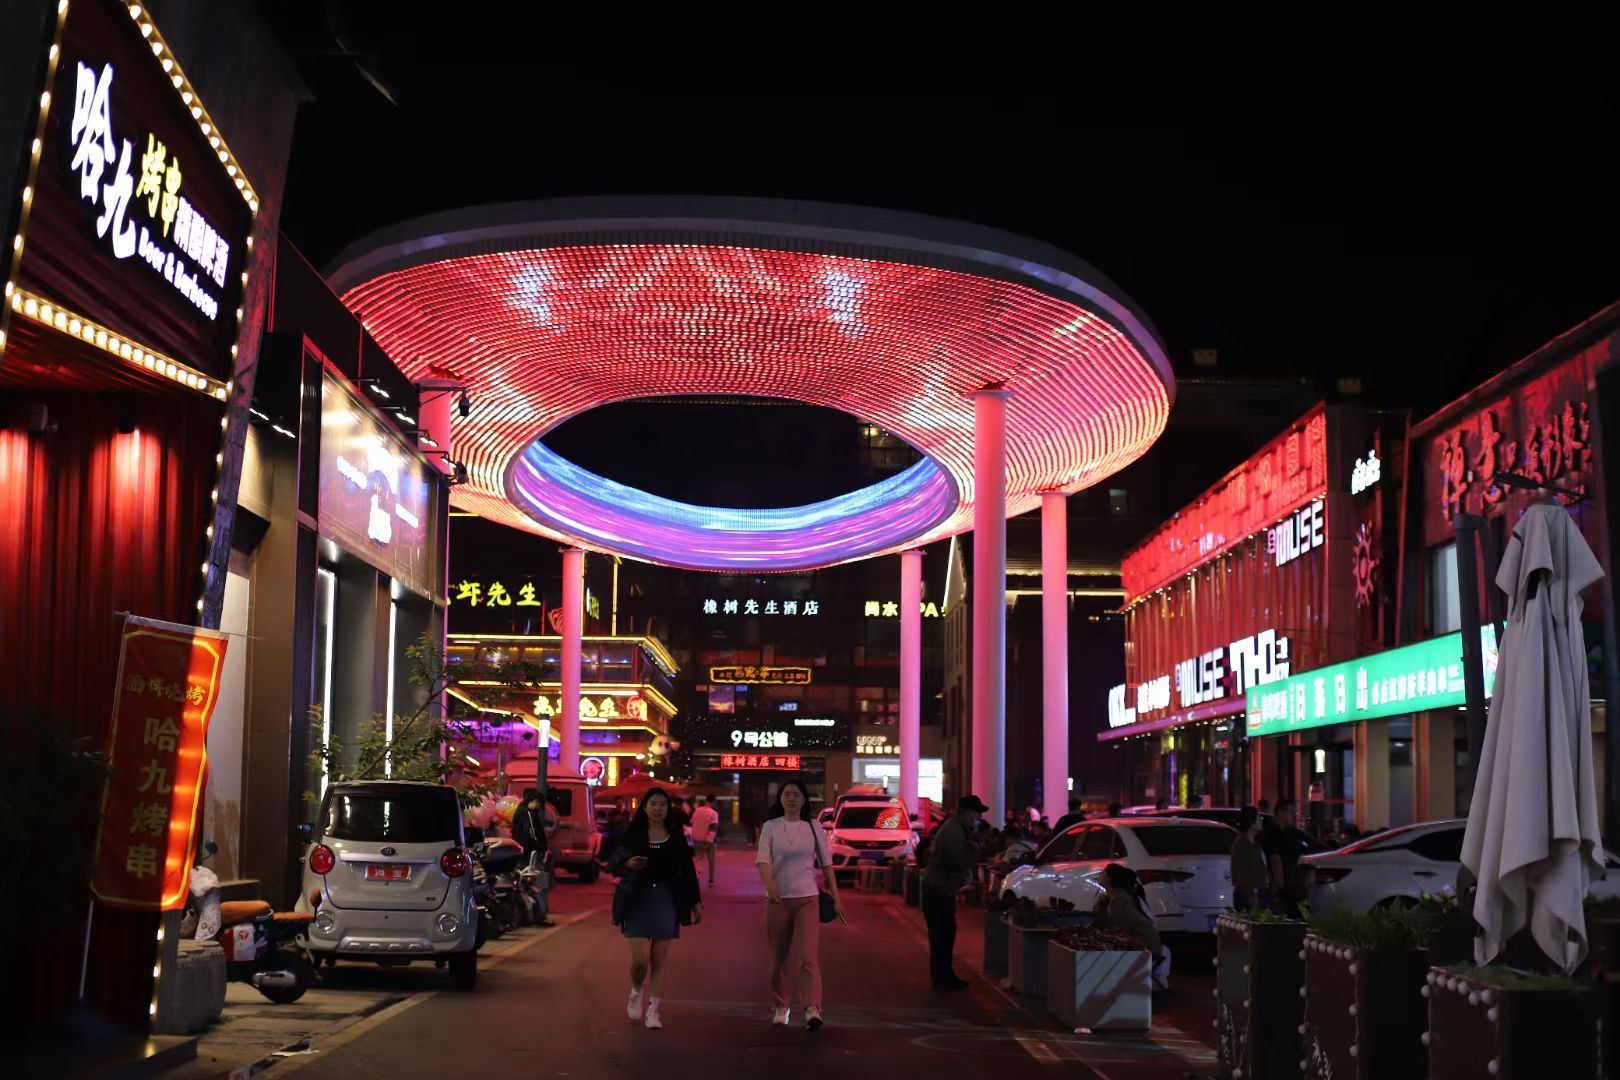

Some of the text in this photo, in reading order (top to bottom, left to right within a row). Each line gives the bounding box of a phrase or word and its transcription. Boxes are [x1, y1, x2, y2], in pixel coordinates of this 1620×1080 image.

[71, 61, 136, 259] 哈九
[136, 133, 182, 237] 烤串
[447, 580, 541, 607] 虾先生
[703, 599, 819, 615] 橡树先生酒店
[126, 717, 179, 880] 哈九烤串
